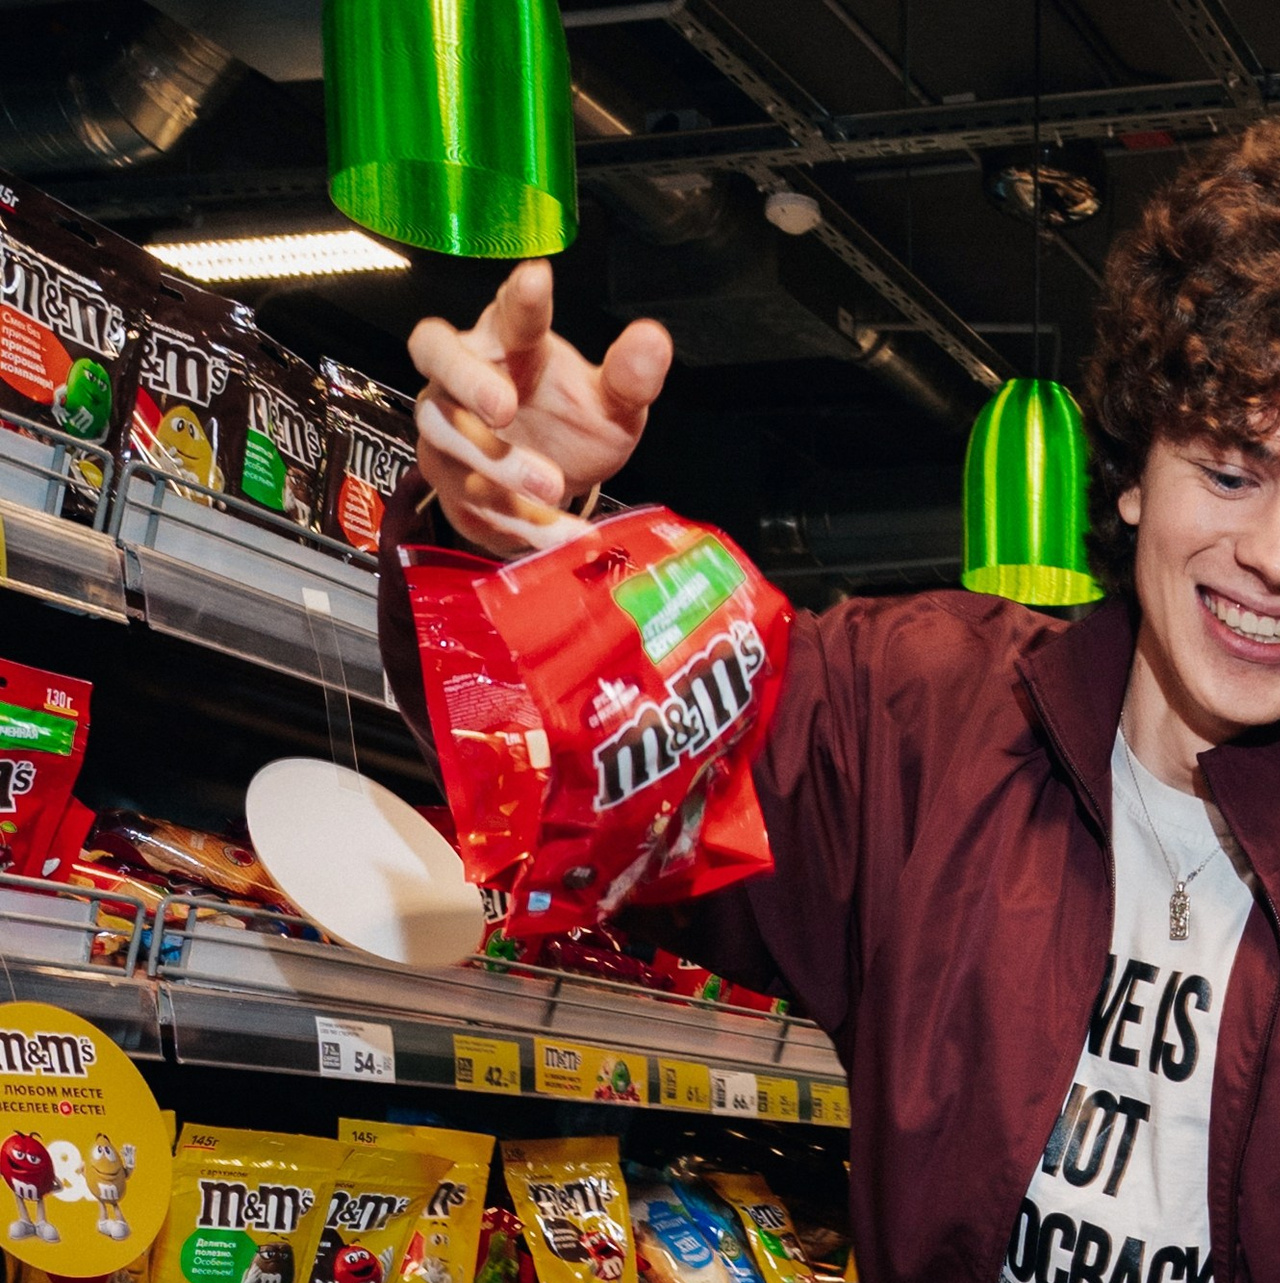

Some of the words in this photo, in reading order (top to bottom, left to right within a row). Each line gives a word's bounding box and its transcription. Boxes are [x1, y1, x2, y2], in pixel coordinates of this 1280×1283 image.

[140, 333, 230, 408] &m's
[46, 688, 73, 709] 130г
[1149, 969, 1212, 1082] IS
[354, 1051, 375, 1074] 54
[4, 1085, 57, 1099] ЛЮБОМ
[62, 1088, 103, 1099] МЕСТЕ
[191, 1135, 219, 1148] 145г
[352, 1131, 377, 1143] 145г
[196, 1178, 315, 1233] m&m's
[193, 1257, 235, 1267] Особенно
